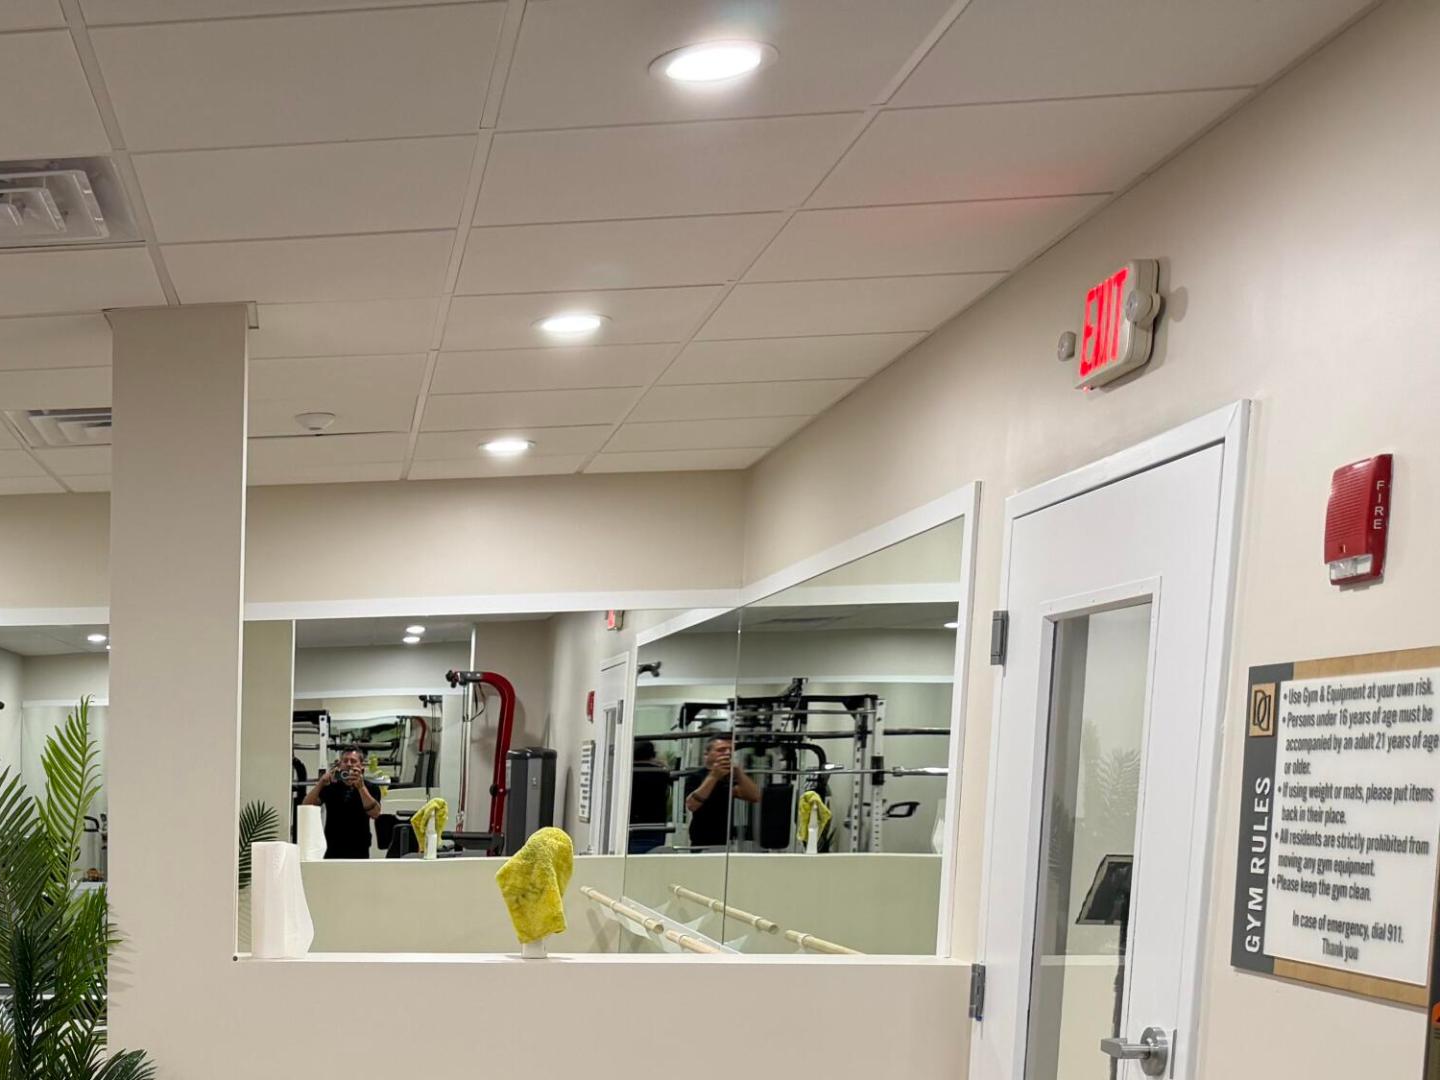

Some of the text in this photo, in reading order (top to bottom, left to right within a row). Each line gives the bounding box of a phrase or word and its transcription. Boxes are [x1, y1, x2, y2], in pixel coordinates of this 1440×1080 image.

[1079, 267, 1129, 377] EXIT
[1374, 480, 1385, 530] FIRE
[1288, 688, 1301, 705] Use
[1303, 687, 1318, 707] Gym
[1326, 683, 1365, 705] Equipment
[1367, 682, 1376, 699] at
[1377, 684, 1395, 702] your
[1396, 682, 1414, 698] own
[1415, 677, 1434, 696] risk.
[1287, 704, 1433, 729] Persons under 16 years of age must be
[1285, 730, 1439, 754] accompanied by an adult 21 years of age
[1284, 758, 1311, 775] or older.
[1282, 781, 1434, 805] If using weight or mats, please put items
[1281, 805, 1347, 827] back in their place.
[1280, 828, 1429, 855] All residents are strictly prohibited from
[1245, 776, 1271, 953] GYM RULES
[1278, 852, 1375, 878] moving any gym equipment.
[1277, 874, 1371, 901] Please keep the gym clean.
[1292, 909, 1404, 944] In case of emergency, dial 911.
[1321, 937, 1359, 962] Thank you
